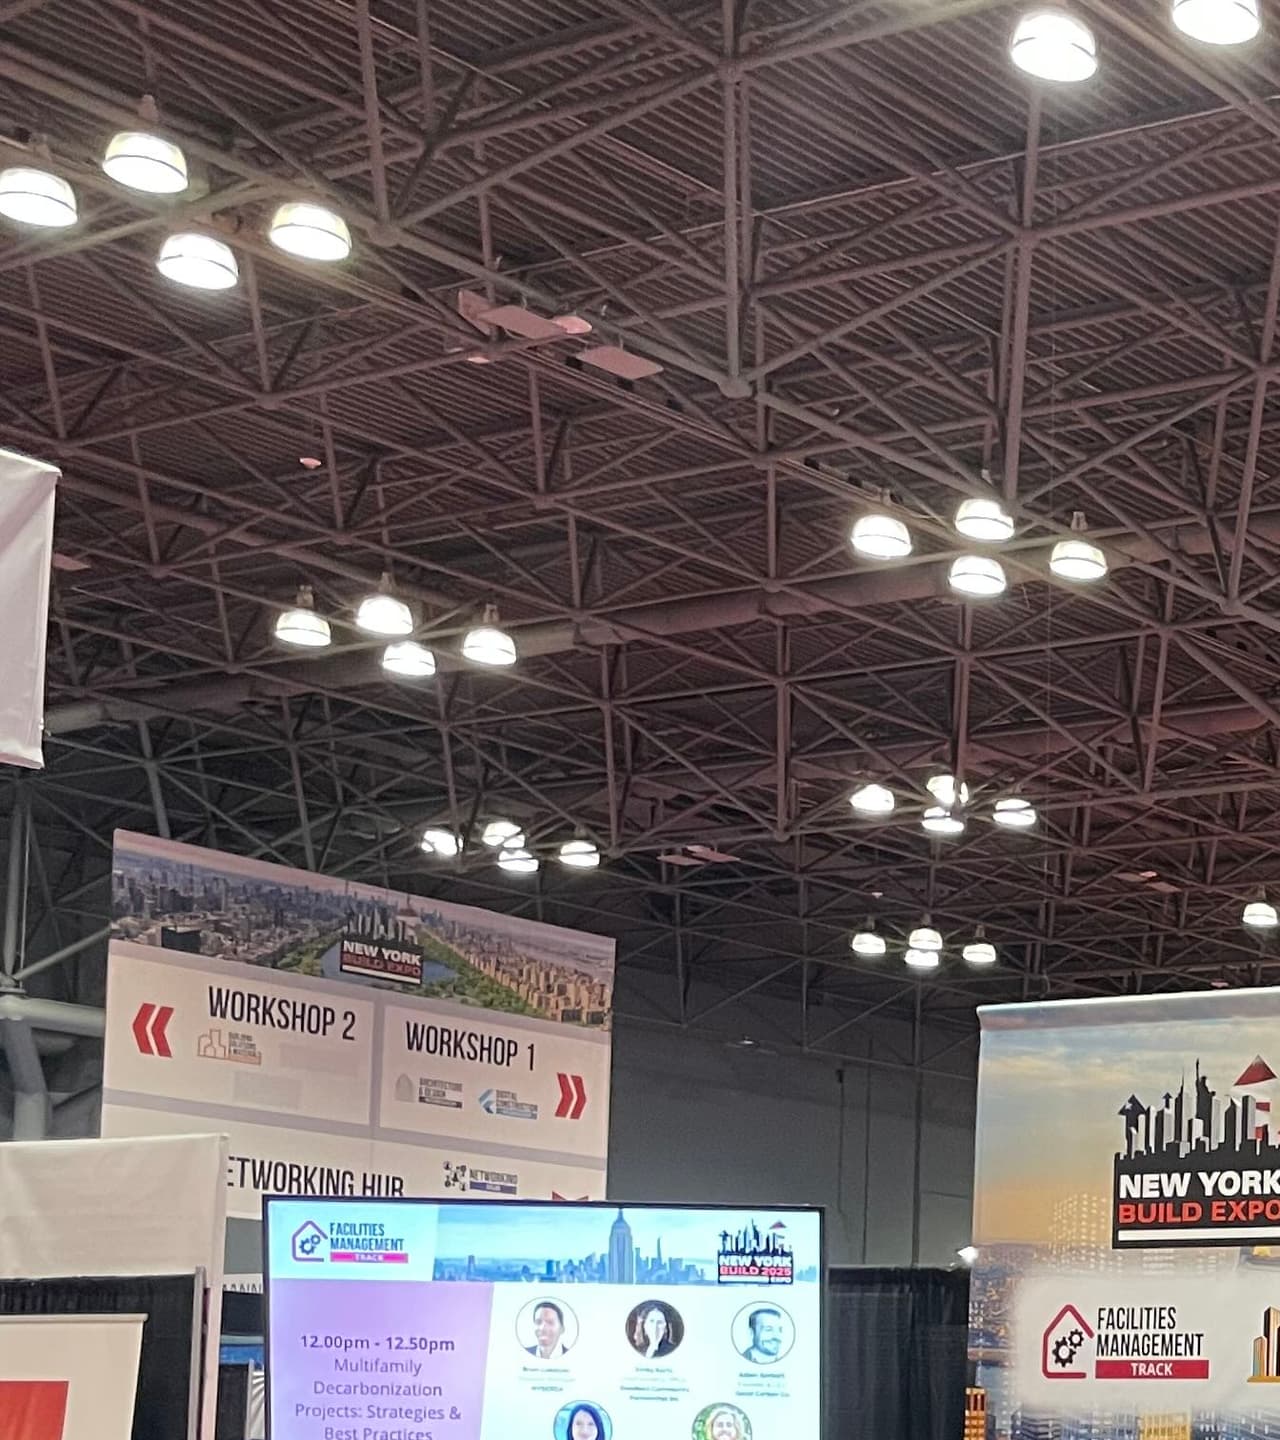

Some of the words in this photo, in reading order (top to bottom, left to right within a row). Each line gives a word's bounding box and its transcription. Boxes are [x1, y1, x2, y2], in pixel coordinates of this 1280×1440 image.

[343, 940, 378, 958] NEW
[382, 948, 421, 966] YORK
[208, 986, 335, 1036] WORKSHOP
[342, 1011, 356, 1040] 2
[406, 1021, 518, 1067] WORKSHOP
[527, 1043, 535, 1071] 1
[227, 1156, 355, 1196] ETWORKING
[1119, 1172, 1191, 1199] NEW
[1118, 1202, 1203, 1224] BUILD
[330, 1222, 385, 1236] FACILITIES
[330, 1236, 404, 1251] MANAGEMENT
[354, 1252, 384, 1262] TRACK
[719, 1255, 753, 1267] NEW
[754, 1255, 792, 1267] YORK
[719, 1266, 760, 1275] BUILD
[760, 1267, 792, 1276] 2025
[1097, 1306, 1177, 1330] FACILITIES
[300, 1335, 370, 1352] 12.00pm
[386, 1337, 455, 1354] 12.50pm
[1096, 1333, 1205, 1357] MANAGEMENT
[334, 1358, 422, 1377] Multifamily
[1130, 1363, 1174, 1377] TRACK
[313, 1381, 443, 1397] Decarbonization
[295, 1404, 362, 1421] Projects:
[367, 1405, 445, 1423] Strategies
[450, 1406, 462, 1420] &
[324, 1427, 358, 1440] Best
